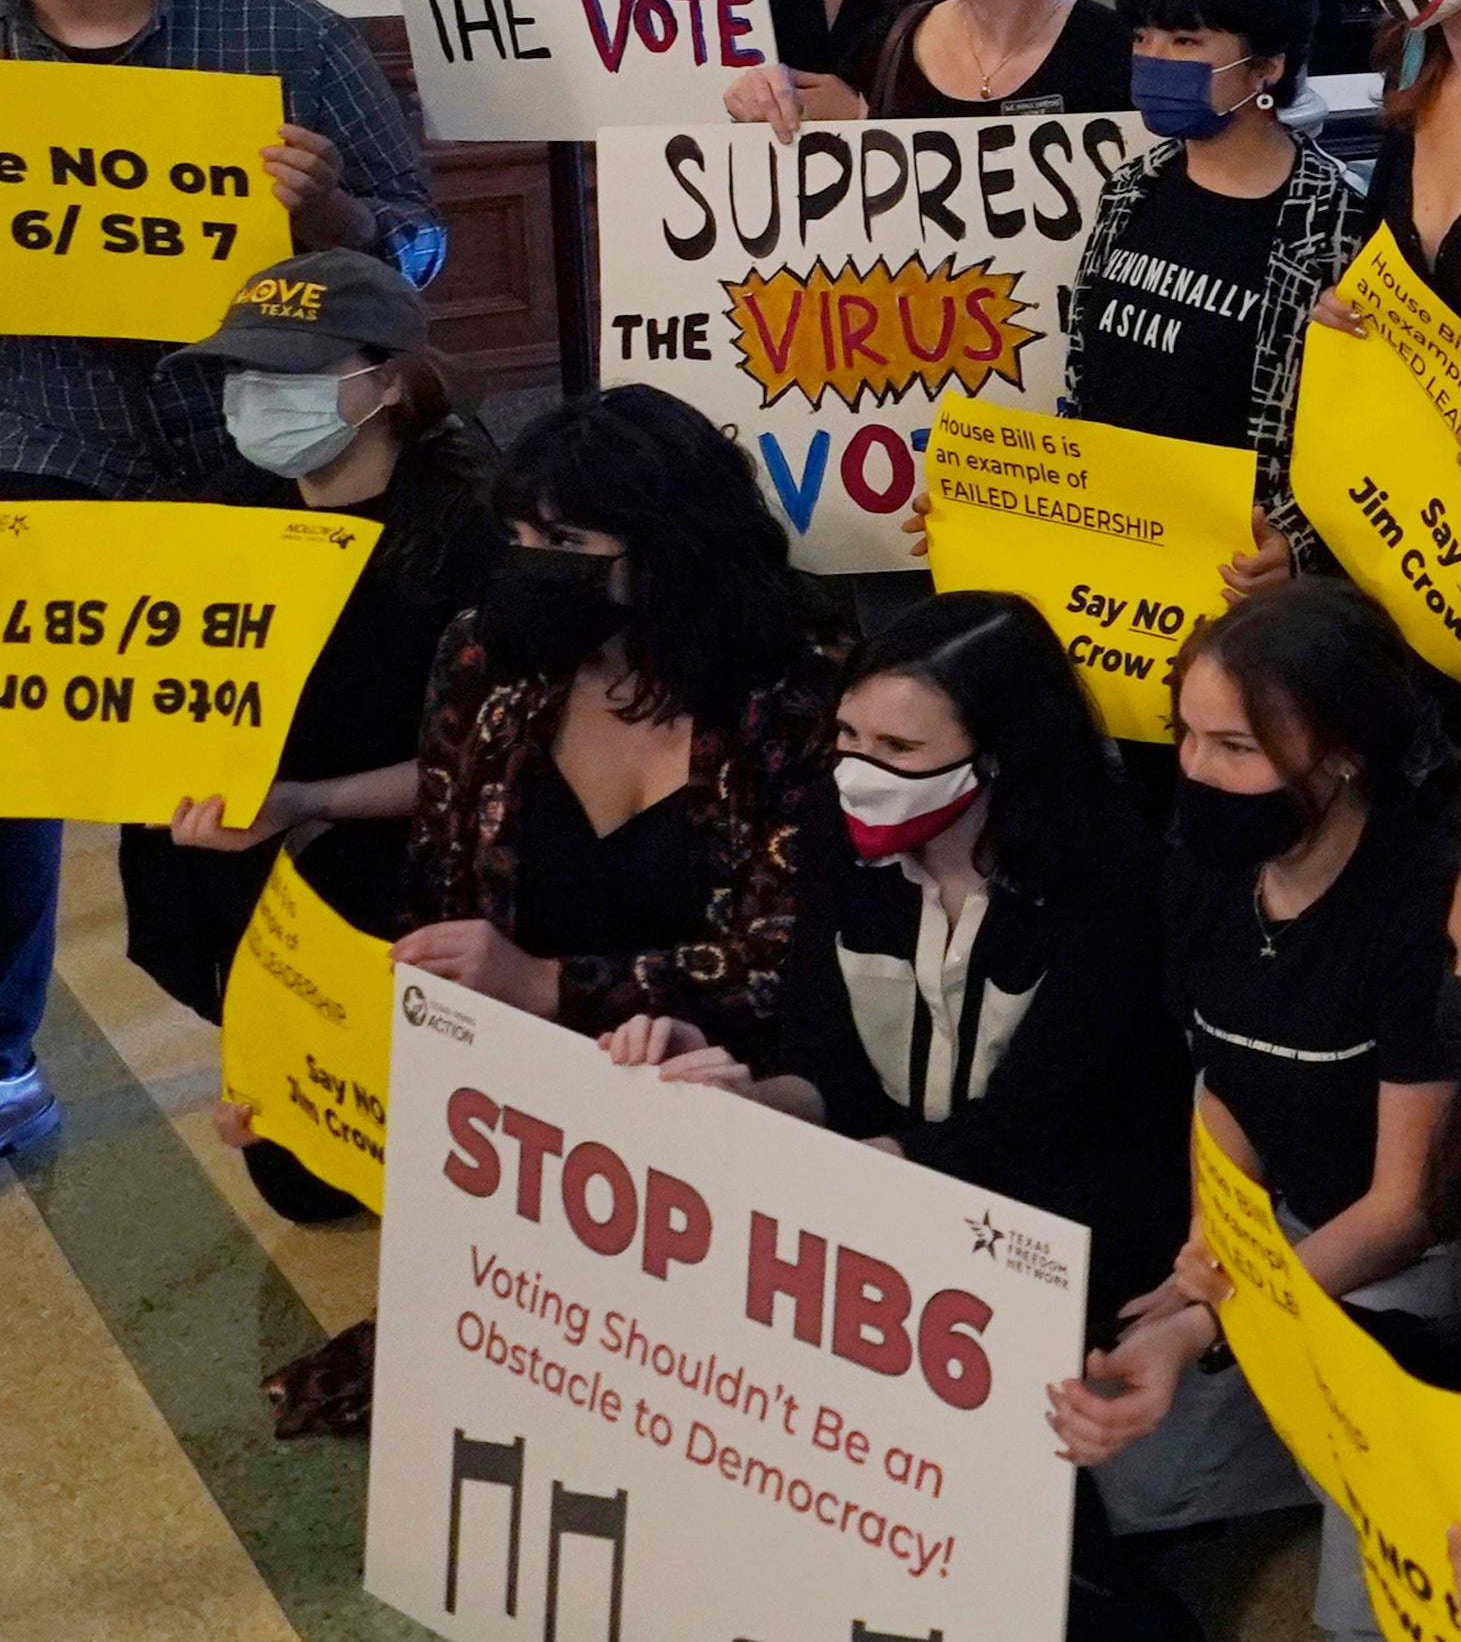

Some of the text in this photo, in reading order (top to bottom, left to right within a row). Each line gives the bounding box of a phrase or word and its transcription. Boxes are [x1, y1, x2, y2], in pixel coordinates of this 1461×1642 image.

[50, 147, 148, 189] NO
[170, 164, 249, 197] on
[11, 205, 237, 260] 6/ SB 7
[261, 304, 317, 320] TEXAS
[1355, 279, 1382, 310] an
[1371, 251, 1432, 324] House
[612, 313, 711, 361] THE
[743, 286, 1004, 373] VIRUS
[1099, 299, 1182, 354] ASIAN
[1350, 300, 1426, 377] FAILED
[940, 412, 1081, 458] House Bill 6 is
[936, 447, 1087, 489] an example of
[941, 479, 1164, 541] FAILED LEADERSHIP
[1348, 476, 1404, 548] Jim
[3, 595, 276, 654] HB 6/ SB 7
[1066, 585, 1184, 634] Say NO
[1068, 636, 1154, 680] Crow
[64, 675, 261, 727] Vote NO
[443, 1087, 713, 1282] STOP
[745, 1210, 994, 1411] HB6
[470, 1245, 944, 1499] Voting Shouldn't Be an
[456, 1309, 953, 1578] Obstacle to Democracy!
